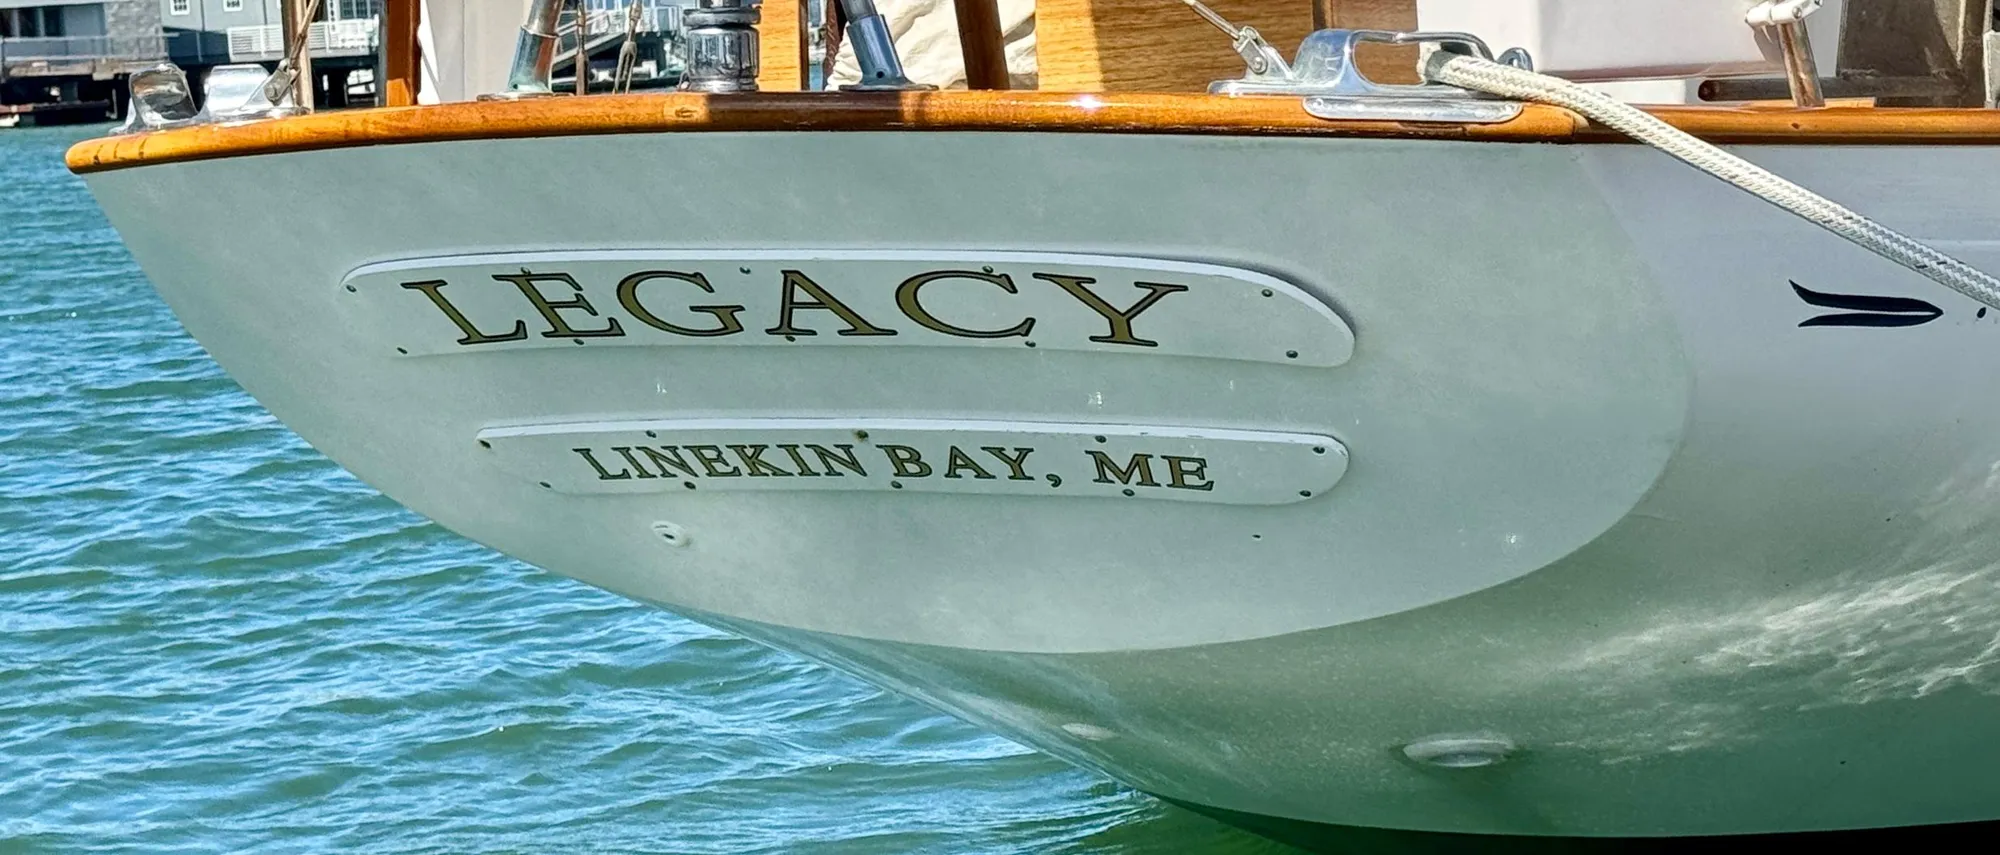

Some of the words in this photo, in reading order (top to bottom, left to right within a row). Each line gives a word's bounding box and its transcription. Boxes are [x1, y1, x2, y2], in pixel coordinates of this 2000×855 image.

[400, 269, 1188, 347] LEGACY
[572, 444, 868, 480] LINEKIN
[876, 444, 1062, 488] BAY,
[1085, 450, 1215, 491] ME
